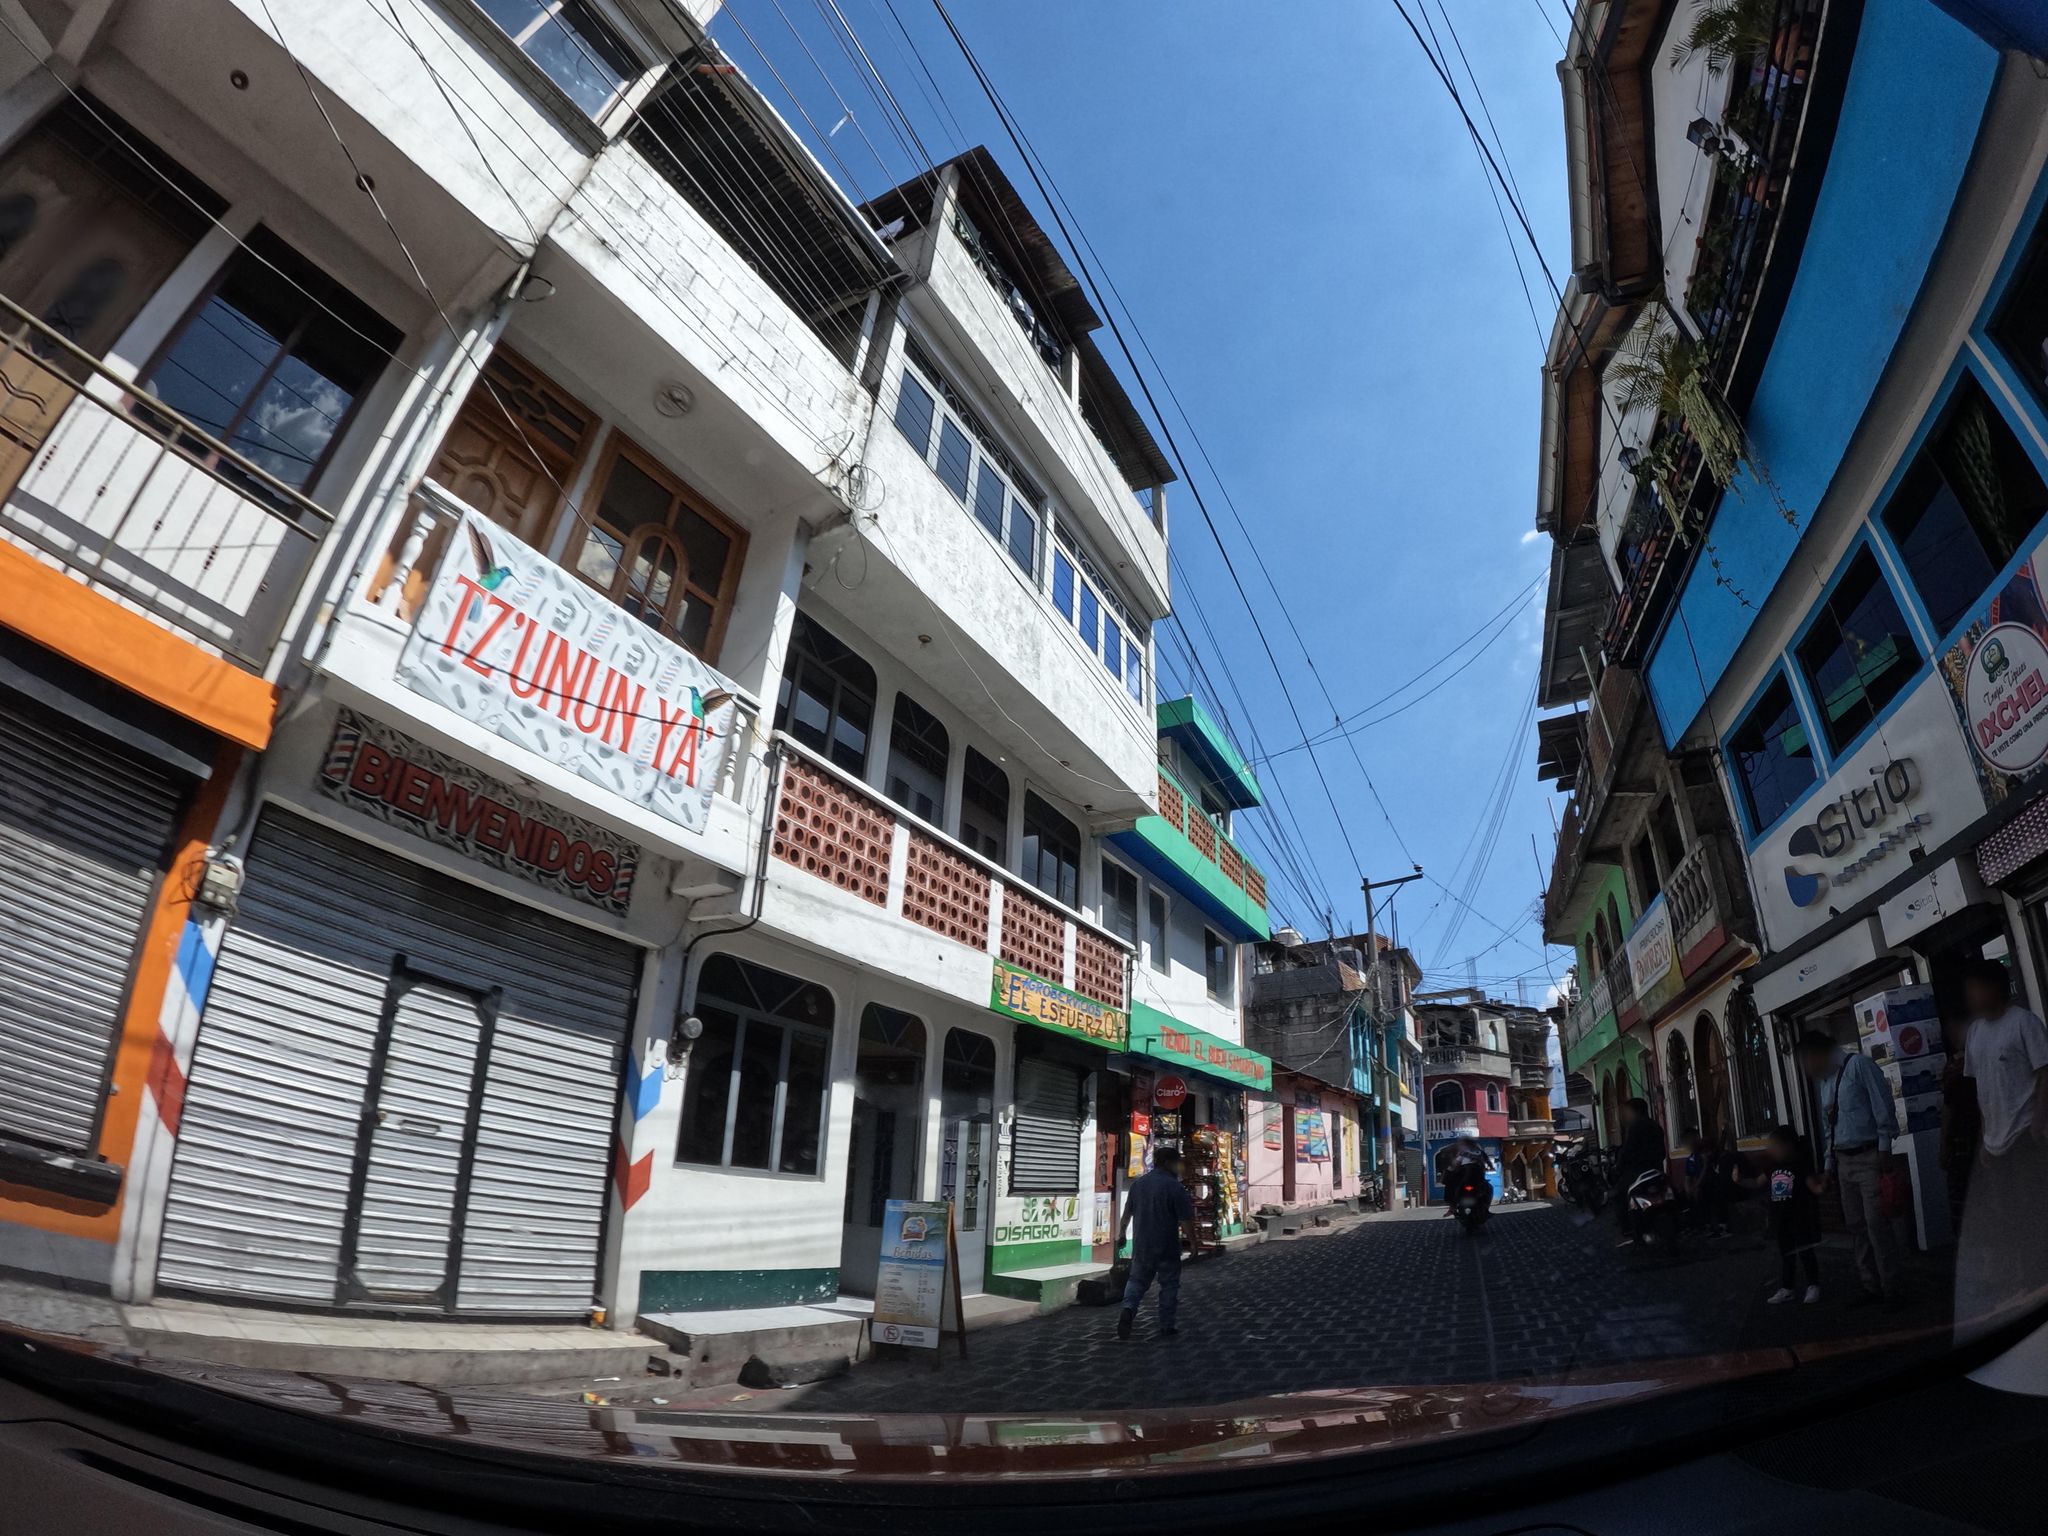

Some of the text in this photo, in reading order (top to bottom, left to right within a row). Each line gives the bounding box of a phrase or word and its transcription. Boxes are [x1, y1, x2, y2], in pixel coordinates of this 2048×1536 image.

[1977, 668, 2048, 749] IXCHEL
[2009, 729, 2023, 745] COMO
[350, 742, 615, 894] BIENVENIDOS
[1008, 974, 1114, 1040] EL ESFUERZO
[1160, 1025, 1191, 1056] TIENDA
[1194, 1039, 1206, 1062] EL
[1156, 1087, 1180, 1097] Claro
